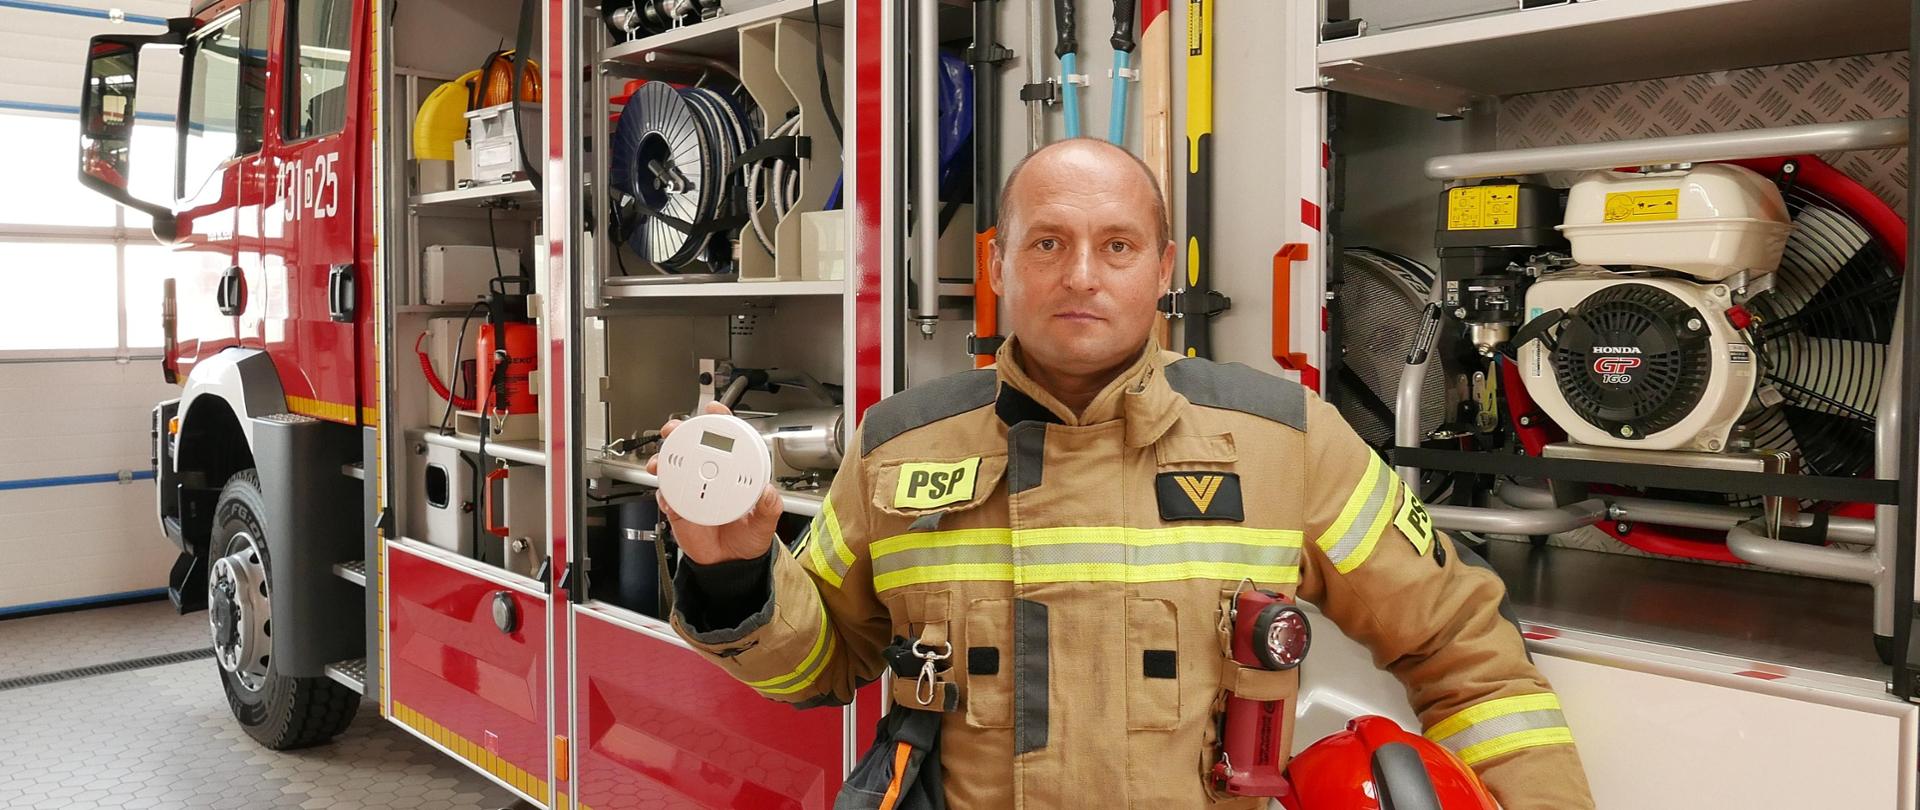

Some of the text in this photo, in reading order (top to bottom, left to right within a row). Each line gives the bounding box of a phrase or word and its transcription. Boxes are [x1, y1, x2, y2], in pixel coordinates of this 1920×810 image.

[314, 151, 339, 219] 25
[1592, 346, 1642, 354] HONDA
[1593, 356, 1641, 374] GP
[1602, 374, 1632, 384] 160
[907, 467, 965, 500] PSP
[1407, 496, 1428, 539] PS
